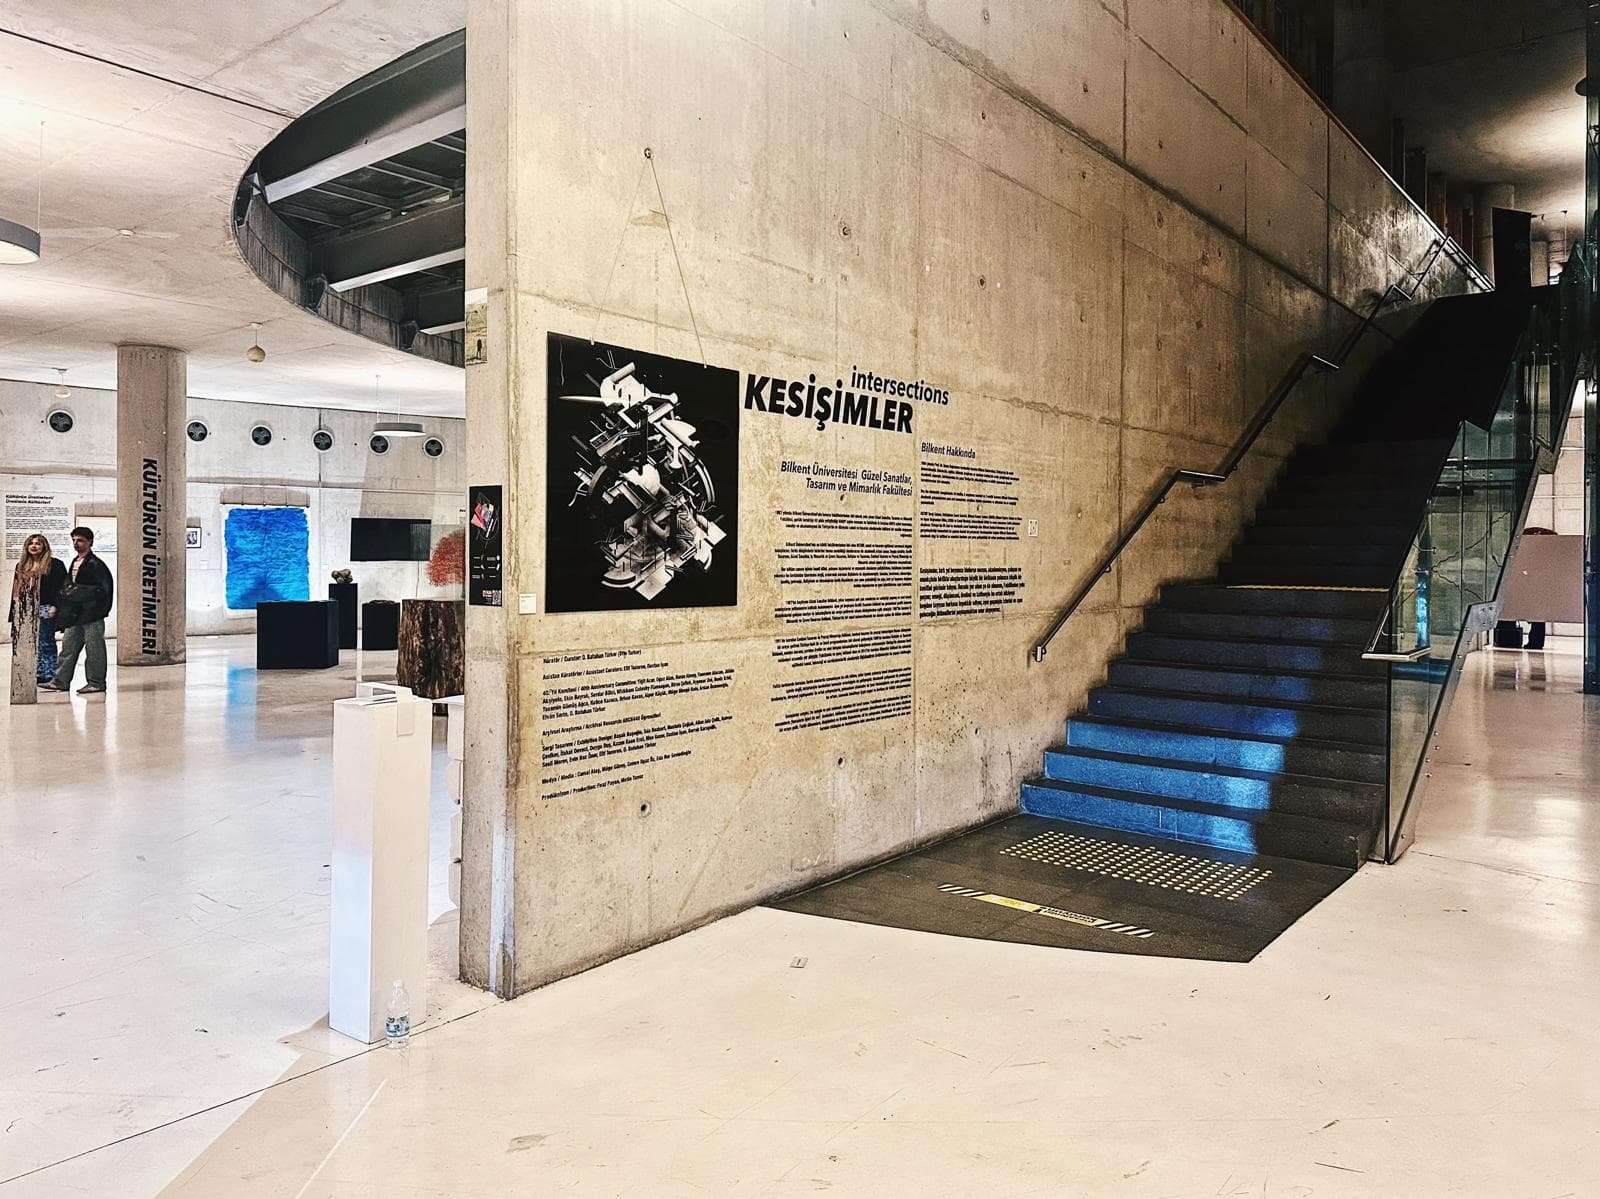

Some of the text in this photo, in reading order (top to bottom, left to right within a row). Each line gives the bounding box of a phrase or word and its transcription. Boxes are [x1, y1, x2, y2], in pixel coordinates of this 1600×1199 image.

[851, 365, 949, 405] intersections
[744, 373, 914, 434] KESİŞİMLER
[921, 442, 976, 459] Bilkent Hakkında
[781, 461, 811, 475] Bilkent
[812, 462, 858, 479] Üniversitesi
[861, 469, 882, 482] Güzel
[883, 471, 913, 485] Sanatlar,
[806, 478, 836, 491] Tasarım
[837, 484, 847, 492] ve
[848, 481, 881, 494] Mimarlık
[882, 484, 913, 497] Fakültesi
[142, 458, 161, 655] KÜLTÜRÜN ÜRETİMLERİ
